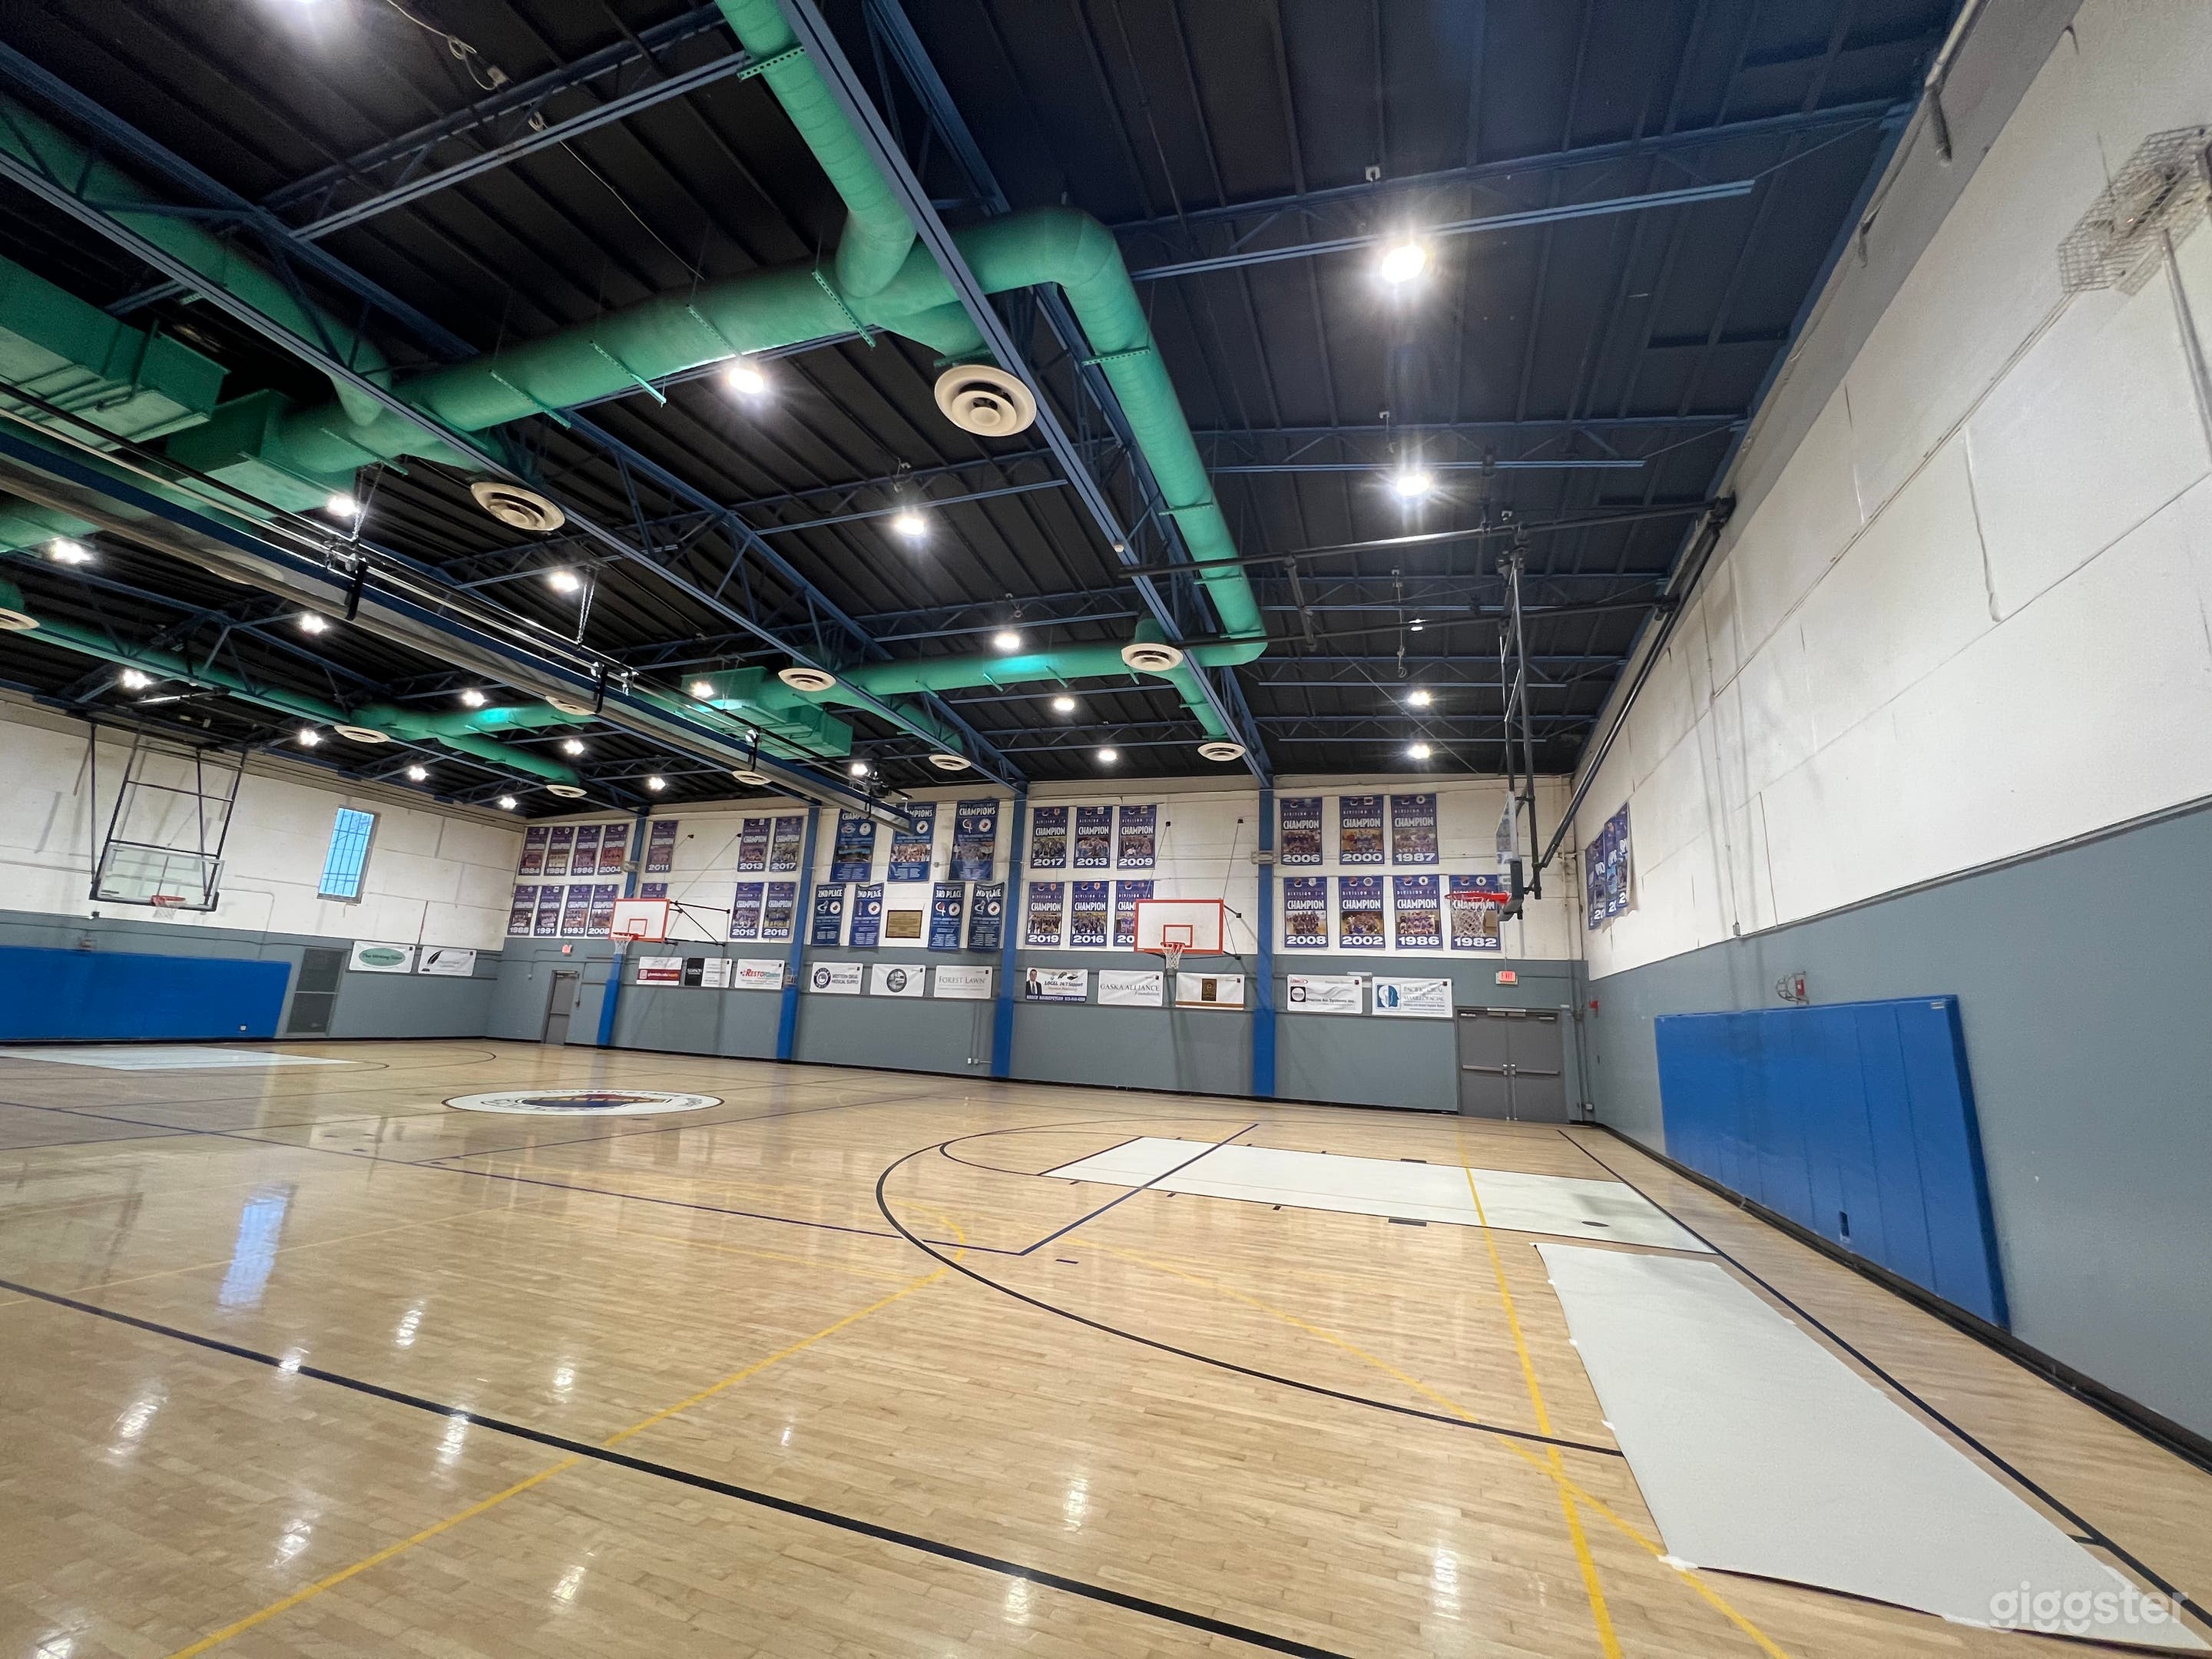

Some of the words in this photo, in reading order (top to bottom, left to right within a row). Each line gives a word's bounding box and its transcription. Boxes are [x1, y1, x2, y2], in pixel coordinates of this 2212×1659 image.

[959, 806, 995, 816] CHAMPIONS
[1283, 820, 1320, 830] CHAMPION
[1343, 818, 1381, 828] CHAMPION
[1395, 817, 1433, 827] CHAMPION
[1035, 826, 1065, 836] CHAMPION
[1078, 826, 1109, 835] CHAMPION
[1121, 826, 1154, 835] CHAMPION
[1118, 857, 1153, 866] 2009
[1283, 854, 1320, 863] 2006
[1342, 853, 1382, 862] 2000
[1396, 853, 1435, 862] 1987
[1031, 902, 1061, 911] CHAMPION
[1075, 902, 1106, 911] CHAMPION
[1118, 902, 1134, 911] CHAM
[1287, 900, 1324, 909] CHAMPION
[1343, 899, 1381, 909] CHAMPION
[1398, 899, 1437, 909] CHAMPION
[1028, 935, 1059, 943] 2019
[1287, 936, 1326, 945] 2008
[1343, 936, 1382, 945] 2002
[1399, 936, 1439, 945] 1986
[1455, 937, 1497, 947] 1982
